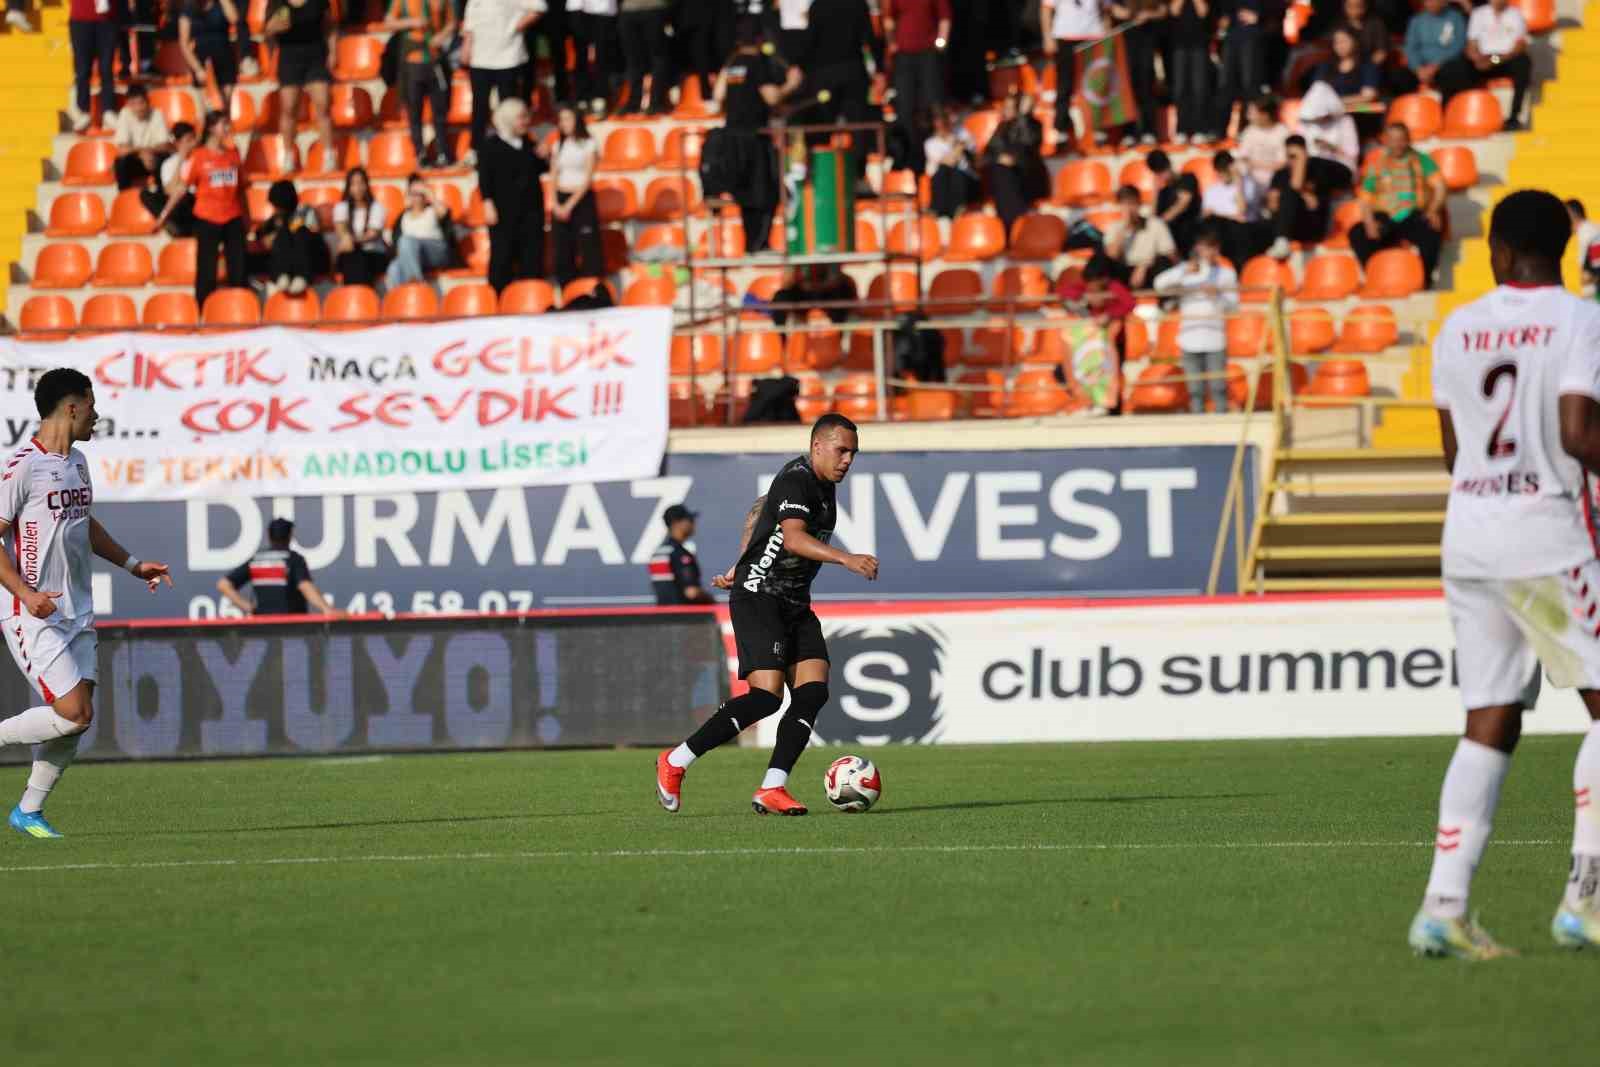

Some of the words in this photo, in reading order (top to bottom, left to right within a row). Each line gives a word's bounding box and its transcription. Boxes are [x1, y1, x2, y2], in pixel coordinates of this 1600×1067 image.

[94, 349, 286, 398] ÇIKTIK
[309, 354, 417, 385] MAÇA
[432, 320, 635, 378] GELDİK
[181, 397, 313, 442] ÇOK
[329, 378, 578, 431] SEVDİK
[1482, 359, 1519, 459] 2
[303, 447, 468, 480] ANADOLU
[480, 438, 590, 472] LİSESİ
[47, 487, 92, 510] CORE
[187, 475, 694, 571] DURMAZ
[757, 467, 1198, 561] NVEST
[78, 628, 561, 758] OYUYO!
[981, 647, 1143, 700] club
